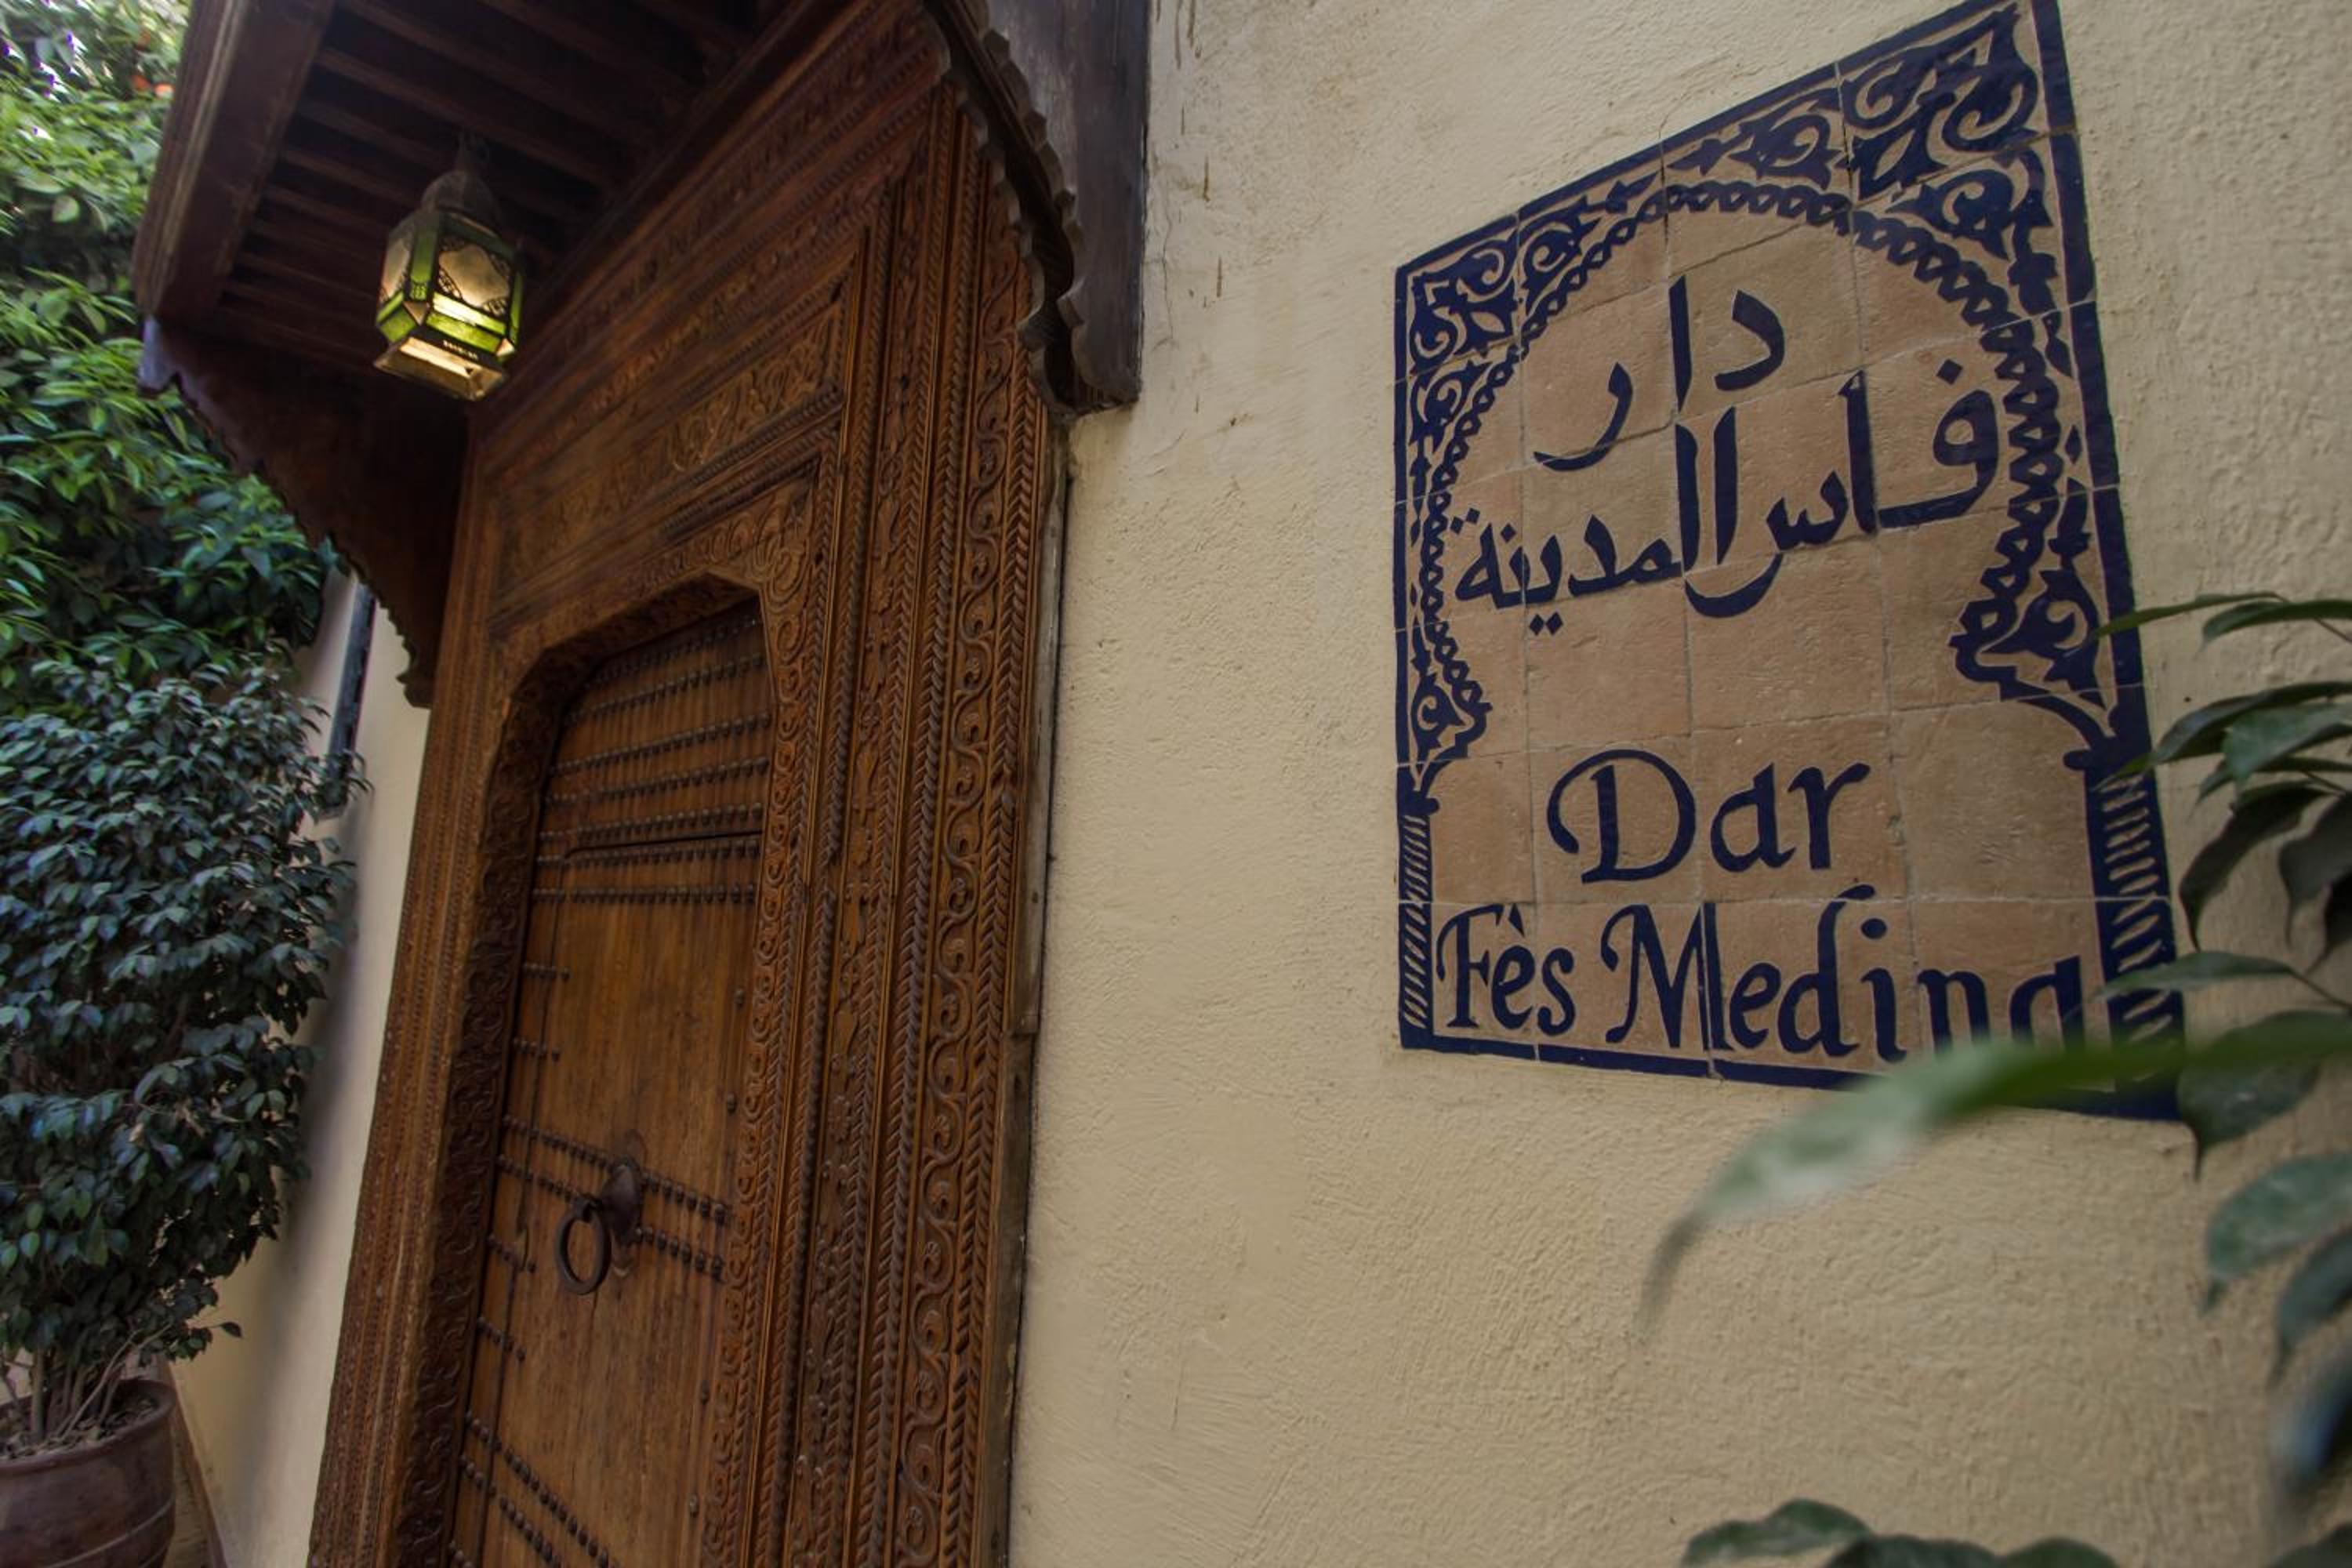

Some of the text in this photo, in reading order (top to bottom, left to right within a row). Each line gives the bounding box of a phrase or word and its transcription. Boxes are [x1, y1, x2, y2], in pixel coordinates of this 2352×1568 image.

[1533, 276, 1785, 471] دار
[1452, 358, 2000, 634] فاس المدينة
[1547, 749, 1871, 884] Dar
[1436, 884, 2086, 1062] Fès Medina
